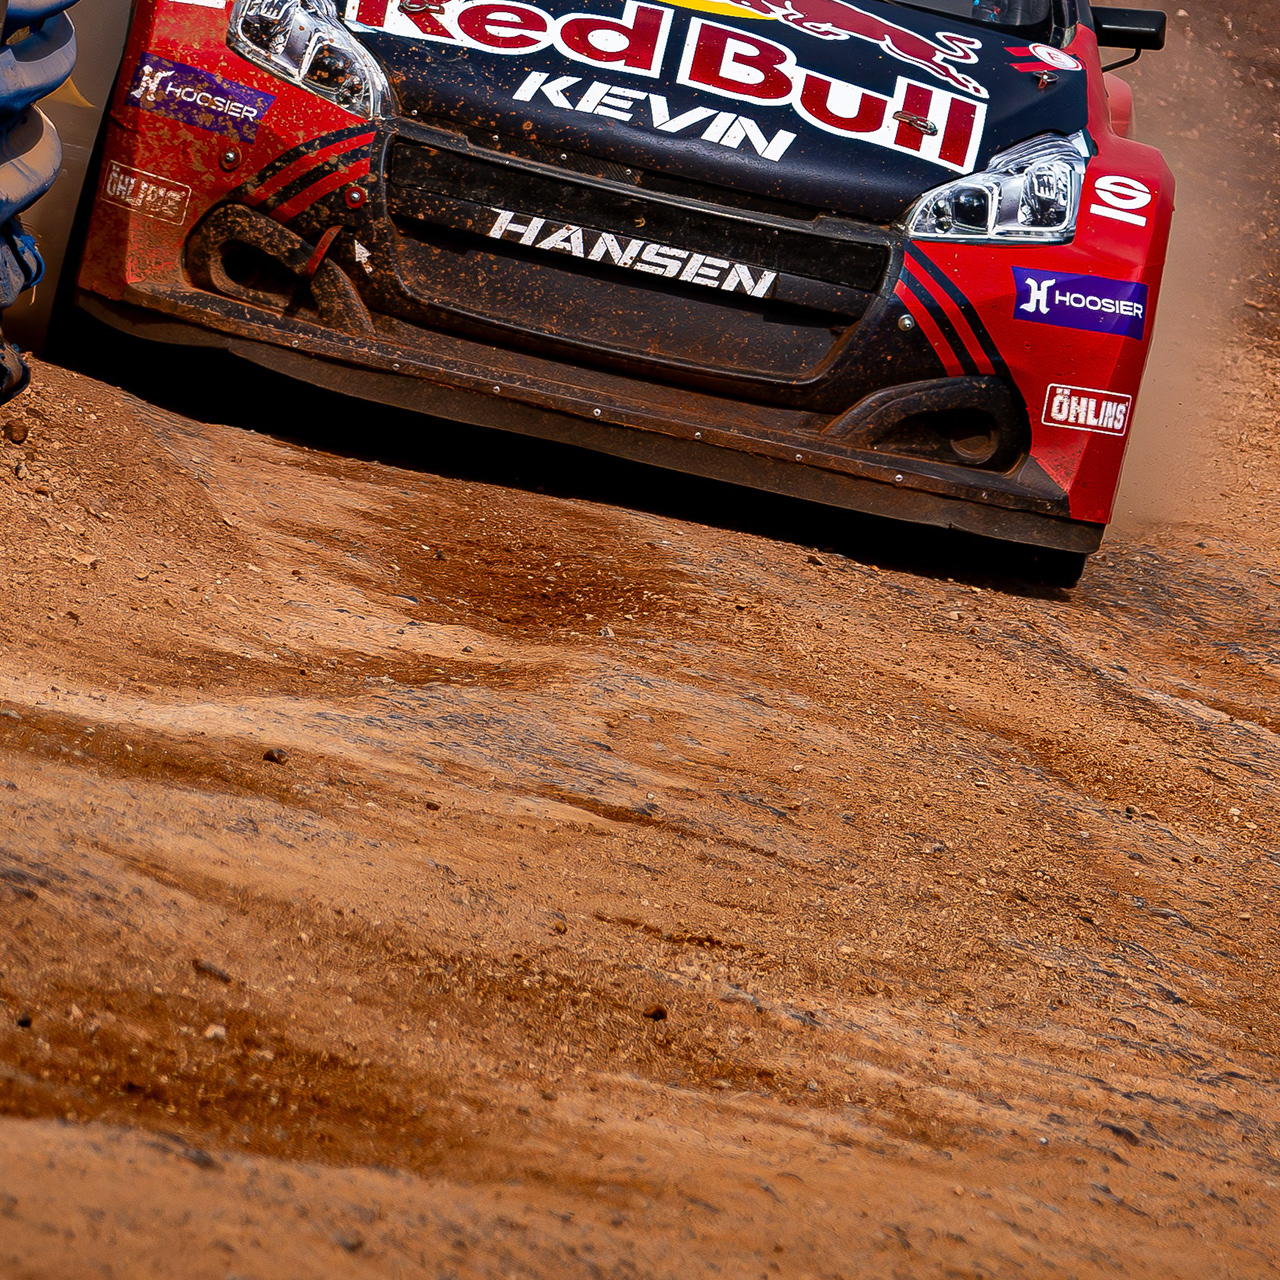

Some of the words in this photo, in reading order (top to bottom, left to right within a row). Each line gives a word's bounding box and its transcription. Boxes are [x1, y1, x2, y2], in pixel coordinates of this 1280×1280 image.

[165, 81, 258, 122] HOOSIER
[512, 70, 797, 162] KEVIN
[680, 18, 986, 173] Bull
[487, 206, 778, 299] HANSEN
[1055, 289, 1143, 319] HOOSIER
[1051, 387, 1127, 430] ÖHLINS
